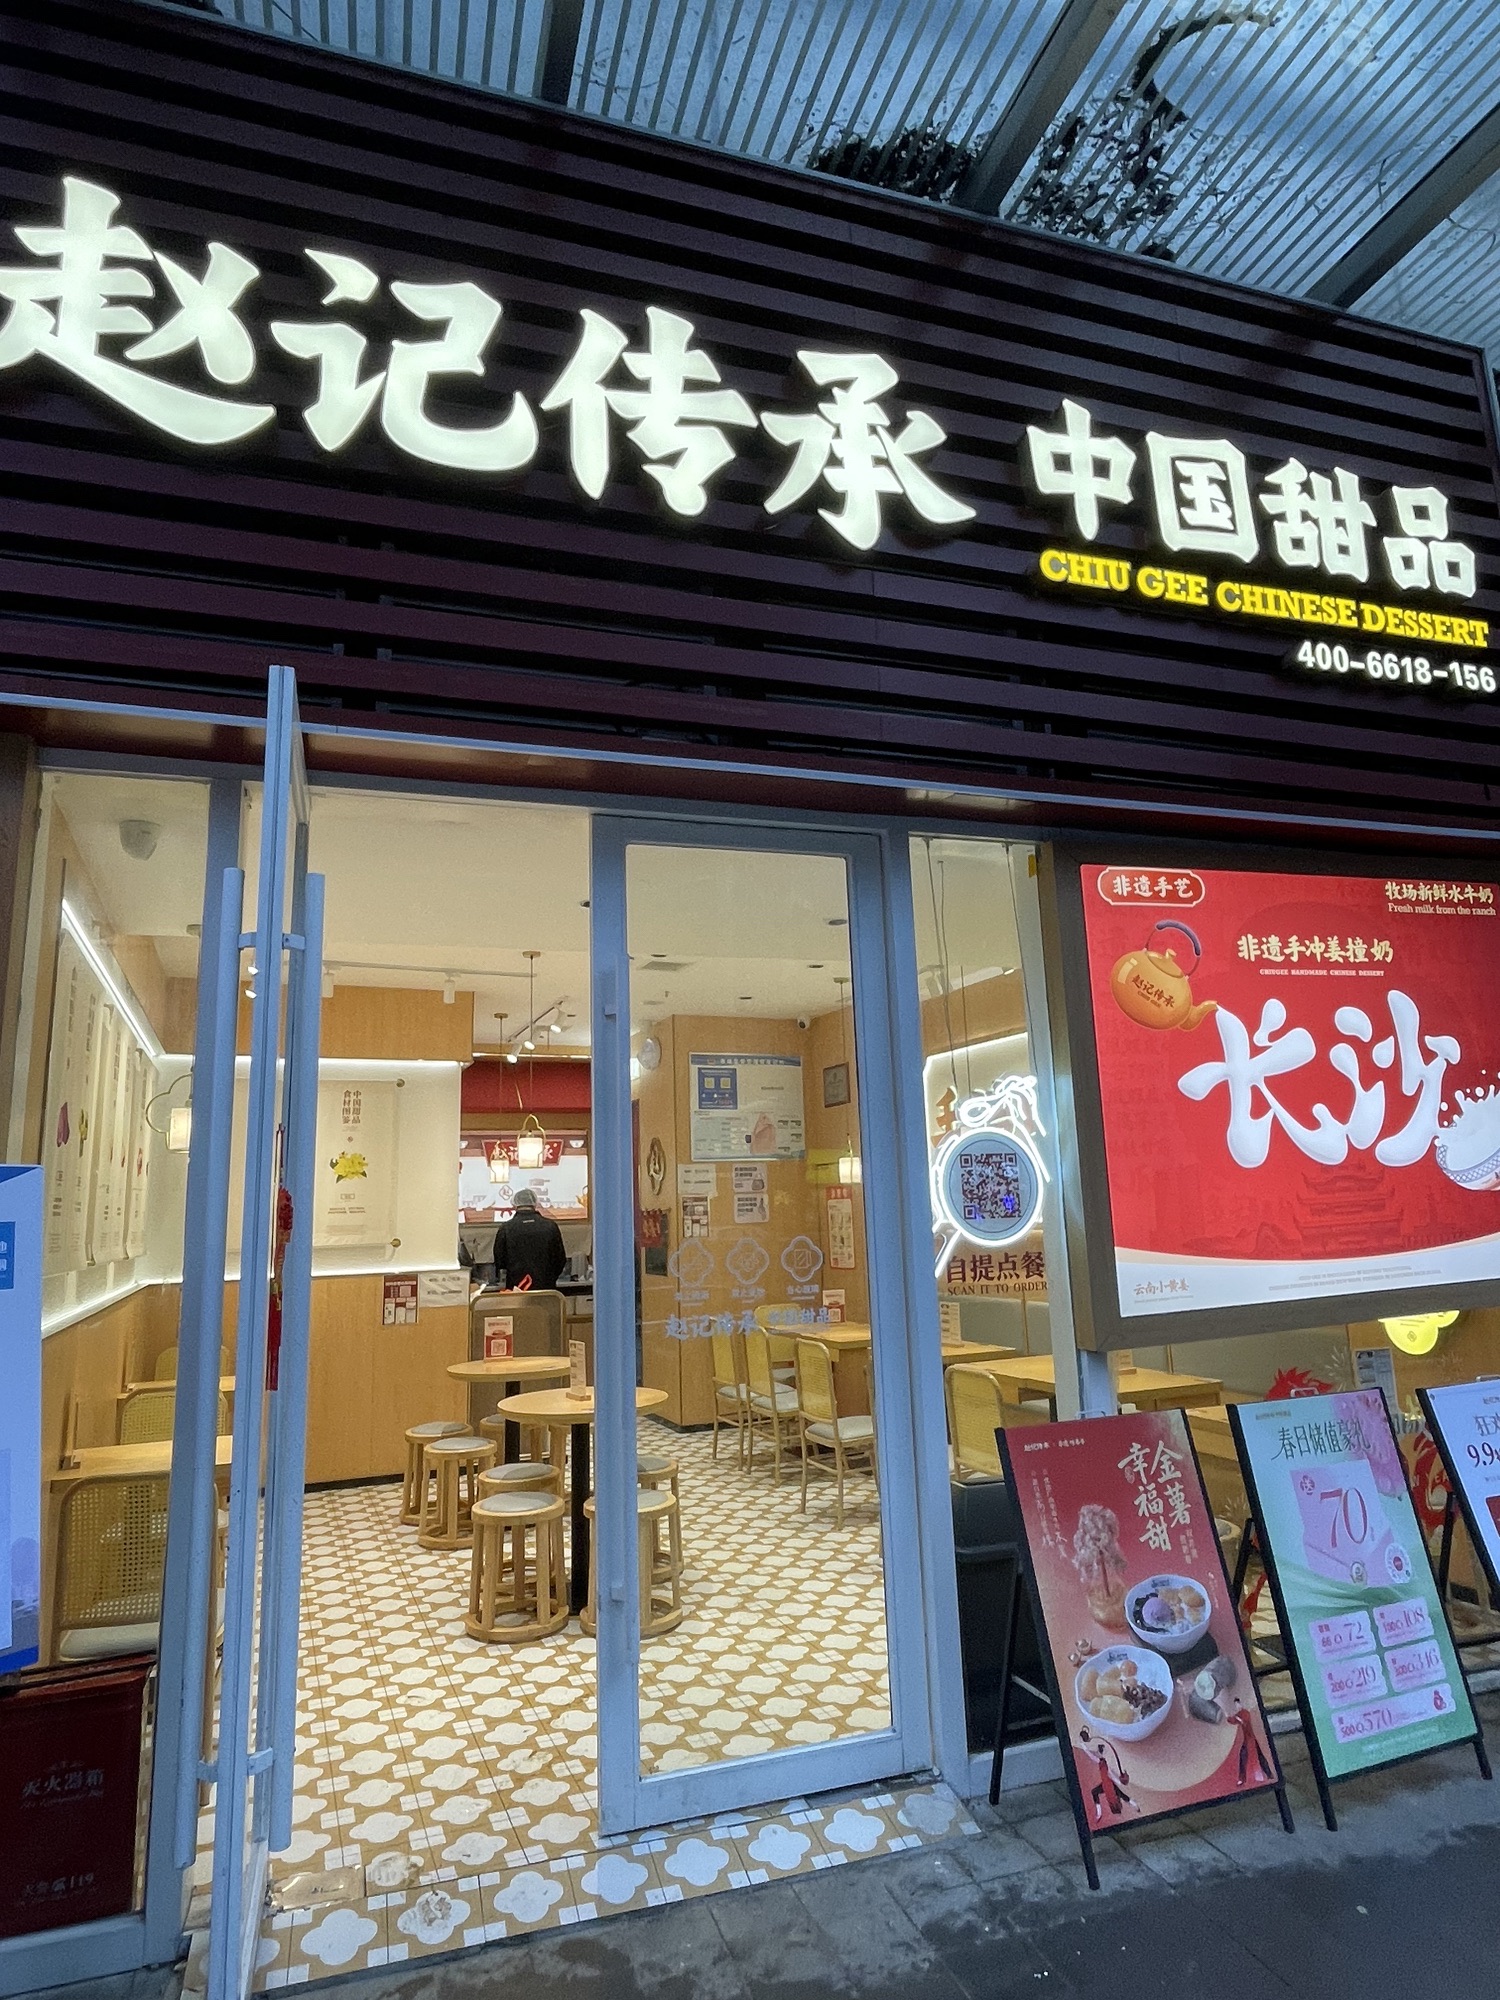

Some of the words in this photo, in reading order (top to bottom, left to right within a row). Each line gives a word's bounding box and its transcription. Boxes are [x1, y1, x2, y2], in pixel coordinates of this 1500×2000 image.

[0, 175, 977, 550] 赵记传承
[1026, 398, 1476, 598] 中国甜品
[1039, 549, 1131, 592] CHIU
[1136, 566, 1209, 606] GEE
[1216, 581, 1358, 628] CHINESE
[1359, 602, 1489, 648] DESSERT
[1297, 639, 1497, 693] 400-6618-156
[1112, 874, 1194, 899] 非遗手艺
[1385, 881, 1494, 905] 牧场新鲜水牛奶
[1388, 903, 1413, 913] Fresh
[1415, 905, 1434, 914] milk
[1436, 905, 1456, 915] from
[1457, 906, 1471, 915] the
[1472, 907, 1497, 916] ranch
[1237, 934, 1394, 964] 非遗手冲姜撞奶
[1177, 990, 1461, 1168] 长沙
[947, 1251, 1046, 1284] 自提点餐
[947, 1285, 976, 1296] SCAN
[979, 1284, 991, 1295] IT
[994, 1283, 1010, 1294] TO
[1013, 1280, 1048, 1293] ORDER
[1118, 1442, 1172, 1551] 幸福甜
[1150, 1440, 1191, 1528] 金薯
[1320, 1487, 1368, 1548] 70
